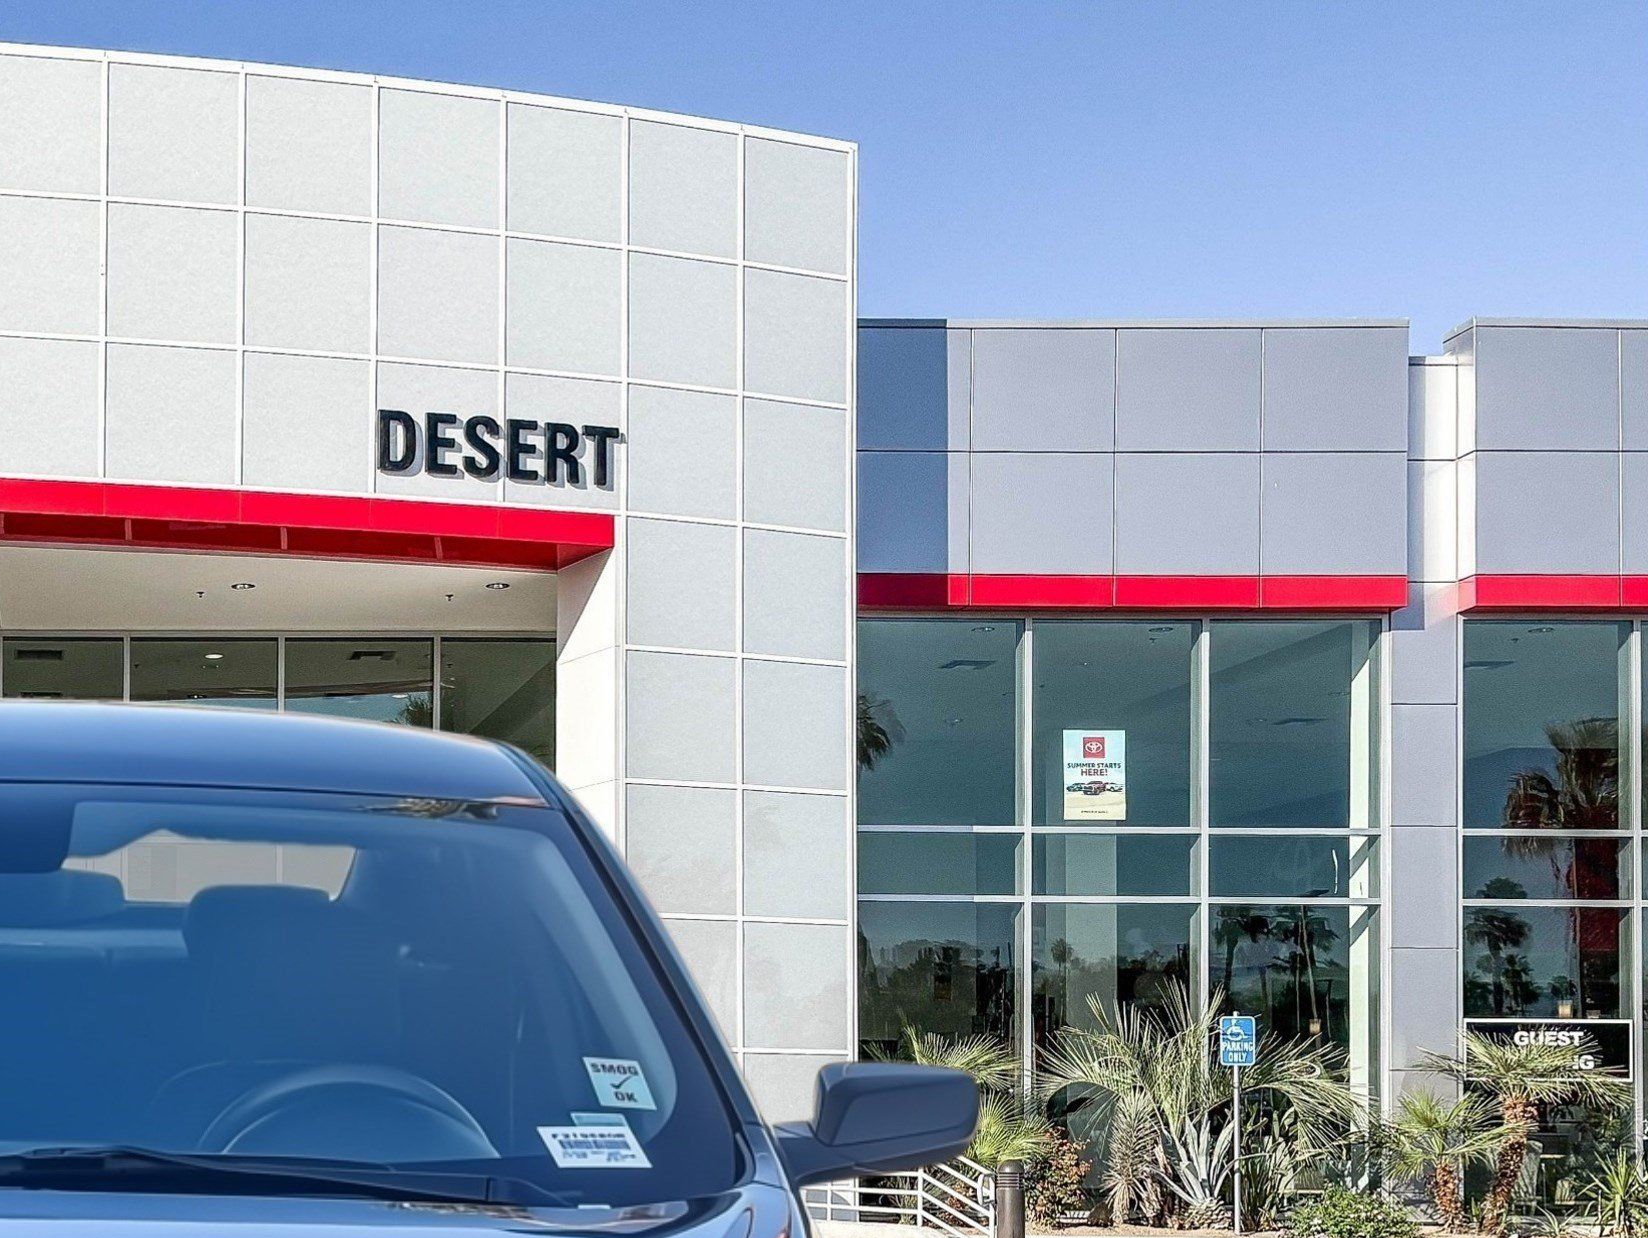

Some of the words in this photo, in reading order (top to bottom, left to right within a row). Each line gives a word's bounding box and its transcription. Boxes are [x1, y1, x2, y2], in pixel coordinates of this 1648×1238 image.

[376, 408, 621, 487] DESERT
[1080, 768, 1108, 776] HERE!
[1513, 1030, 1584, 1047] GUEST
[1222, 1041, 1254, 1051] PARKING
[1228, 1051, 1248, 1062] ONLY
[590, 1062, 639, 1076] SMOG
[613, 1091, 638, 1103] OK
